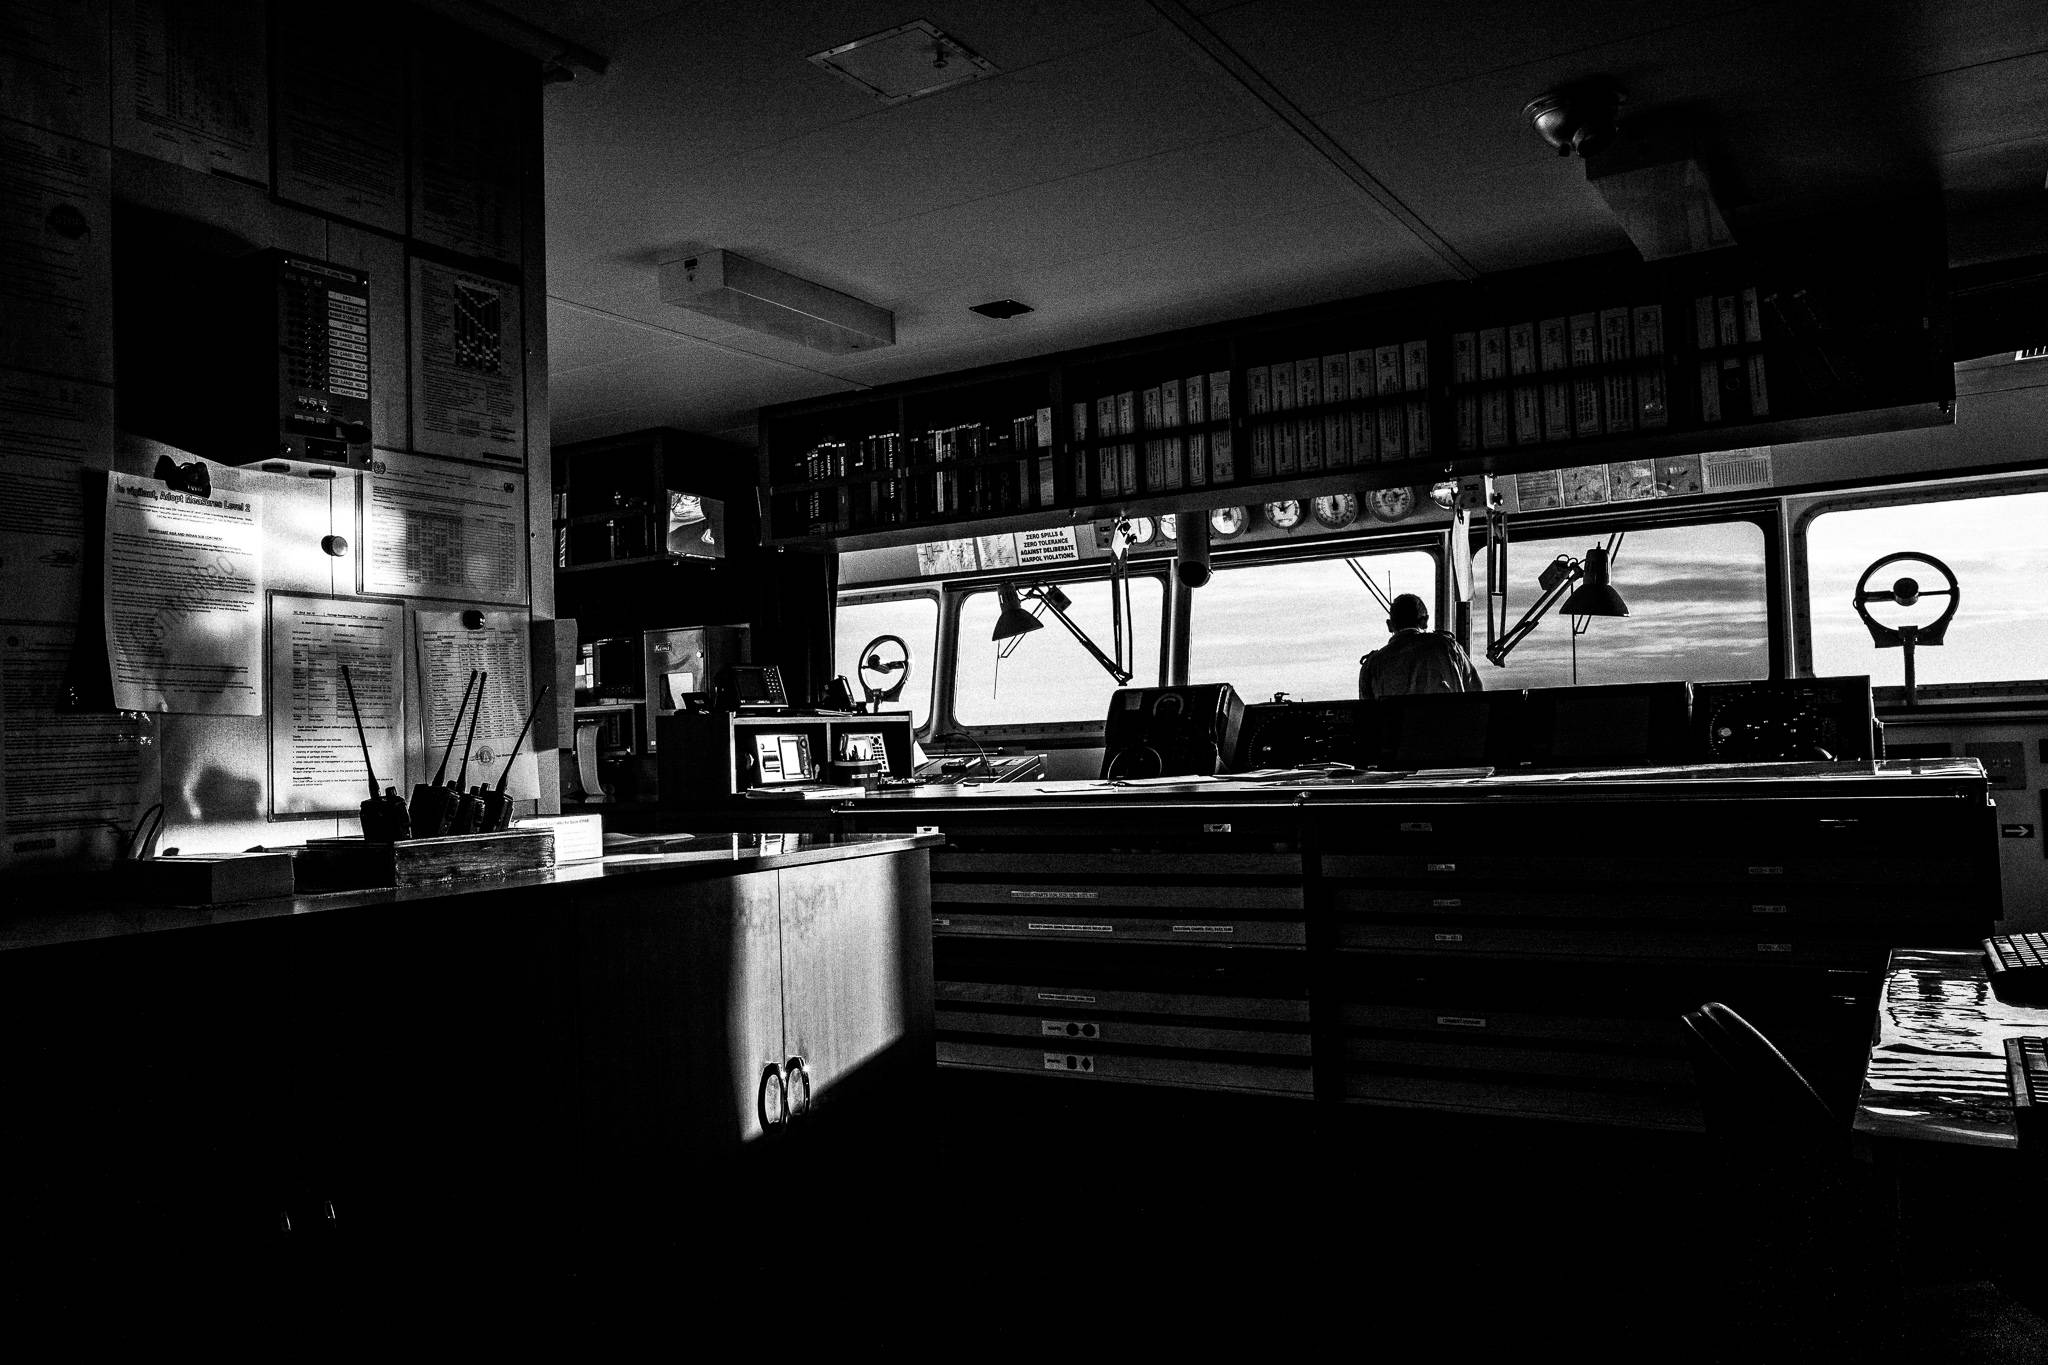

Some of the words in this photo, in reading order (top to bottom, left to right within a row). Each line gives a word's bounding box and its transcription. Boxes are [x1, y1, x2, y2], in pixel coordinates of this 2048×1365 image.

[159, 491, 184, 503] Adopt
[185, 495, 222, 508] Measures
[223, 500, 245, 512] Level
[1038, 538, 1068, 546] TOLERANCE
[1043, 544, 1074, 553] DELIBERATE
[1043, 552, 1076, 560] VIOLATIONS.
